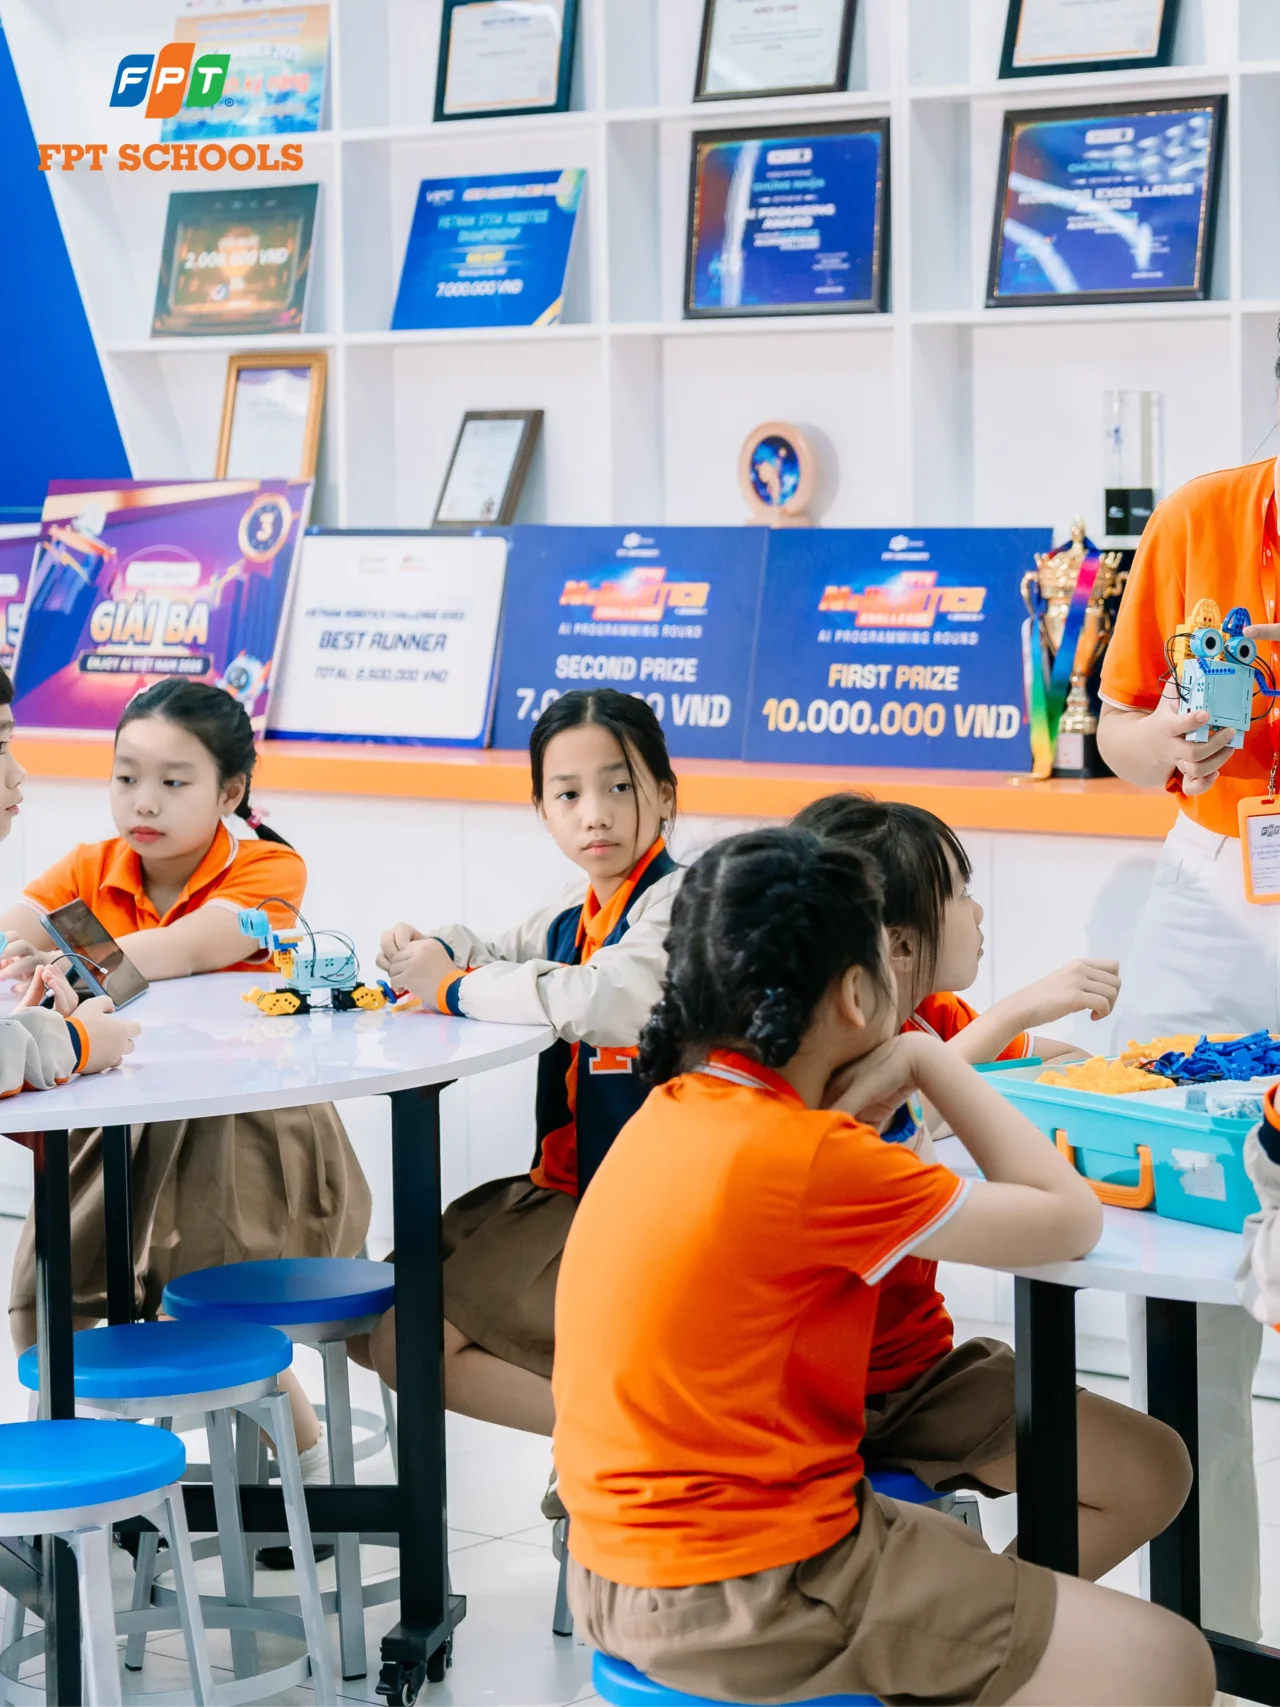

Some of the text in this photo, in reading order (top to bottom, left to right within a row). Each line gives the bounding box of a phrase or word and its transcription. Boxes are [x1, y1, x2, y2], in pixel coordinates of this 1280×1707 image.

[257, 511, 275, 542] 3
[163, 600, 209, 646] BA
[318, 630, 448, 651] BEST RUNNER
[555, 654, 698, 682] SECOND PRIZE
[828, 663, 960, 691] FIRST PRIZE
[670, 694, 732, 727] VND
[762, 698, 1021, 739] 10.000.000 VND
